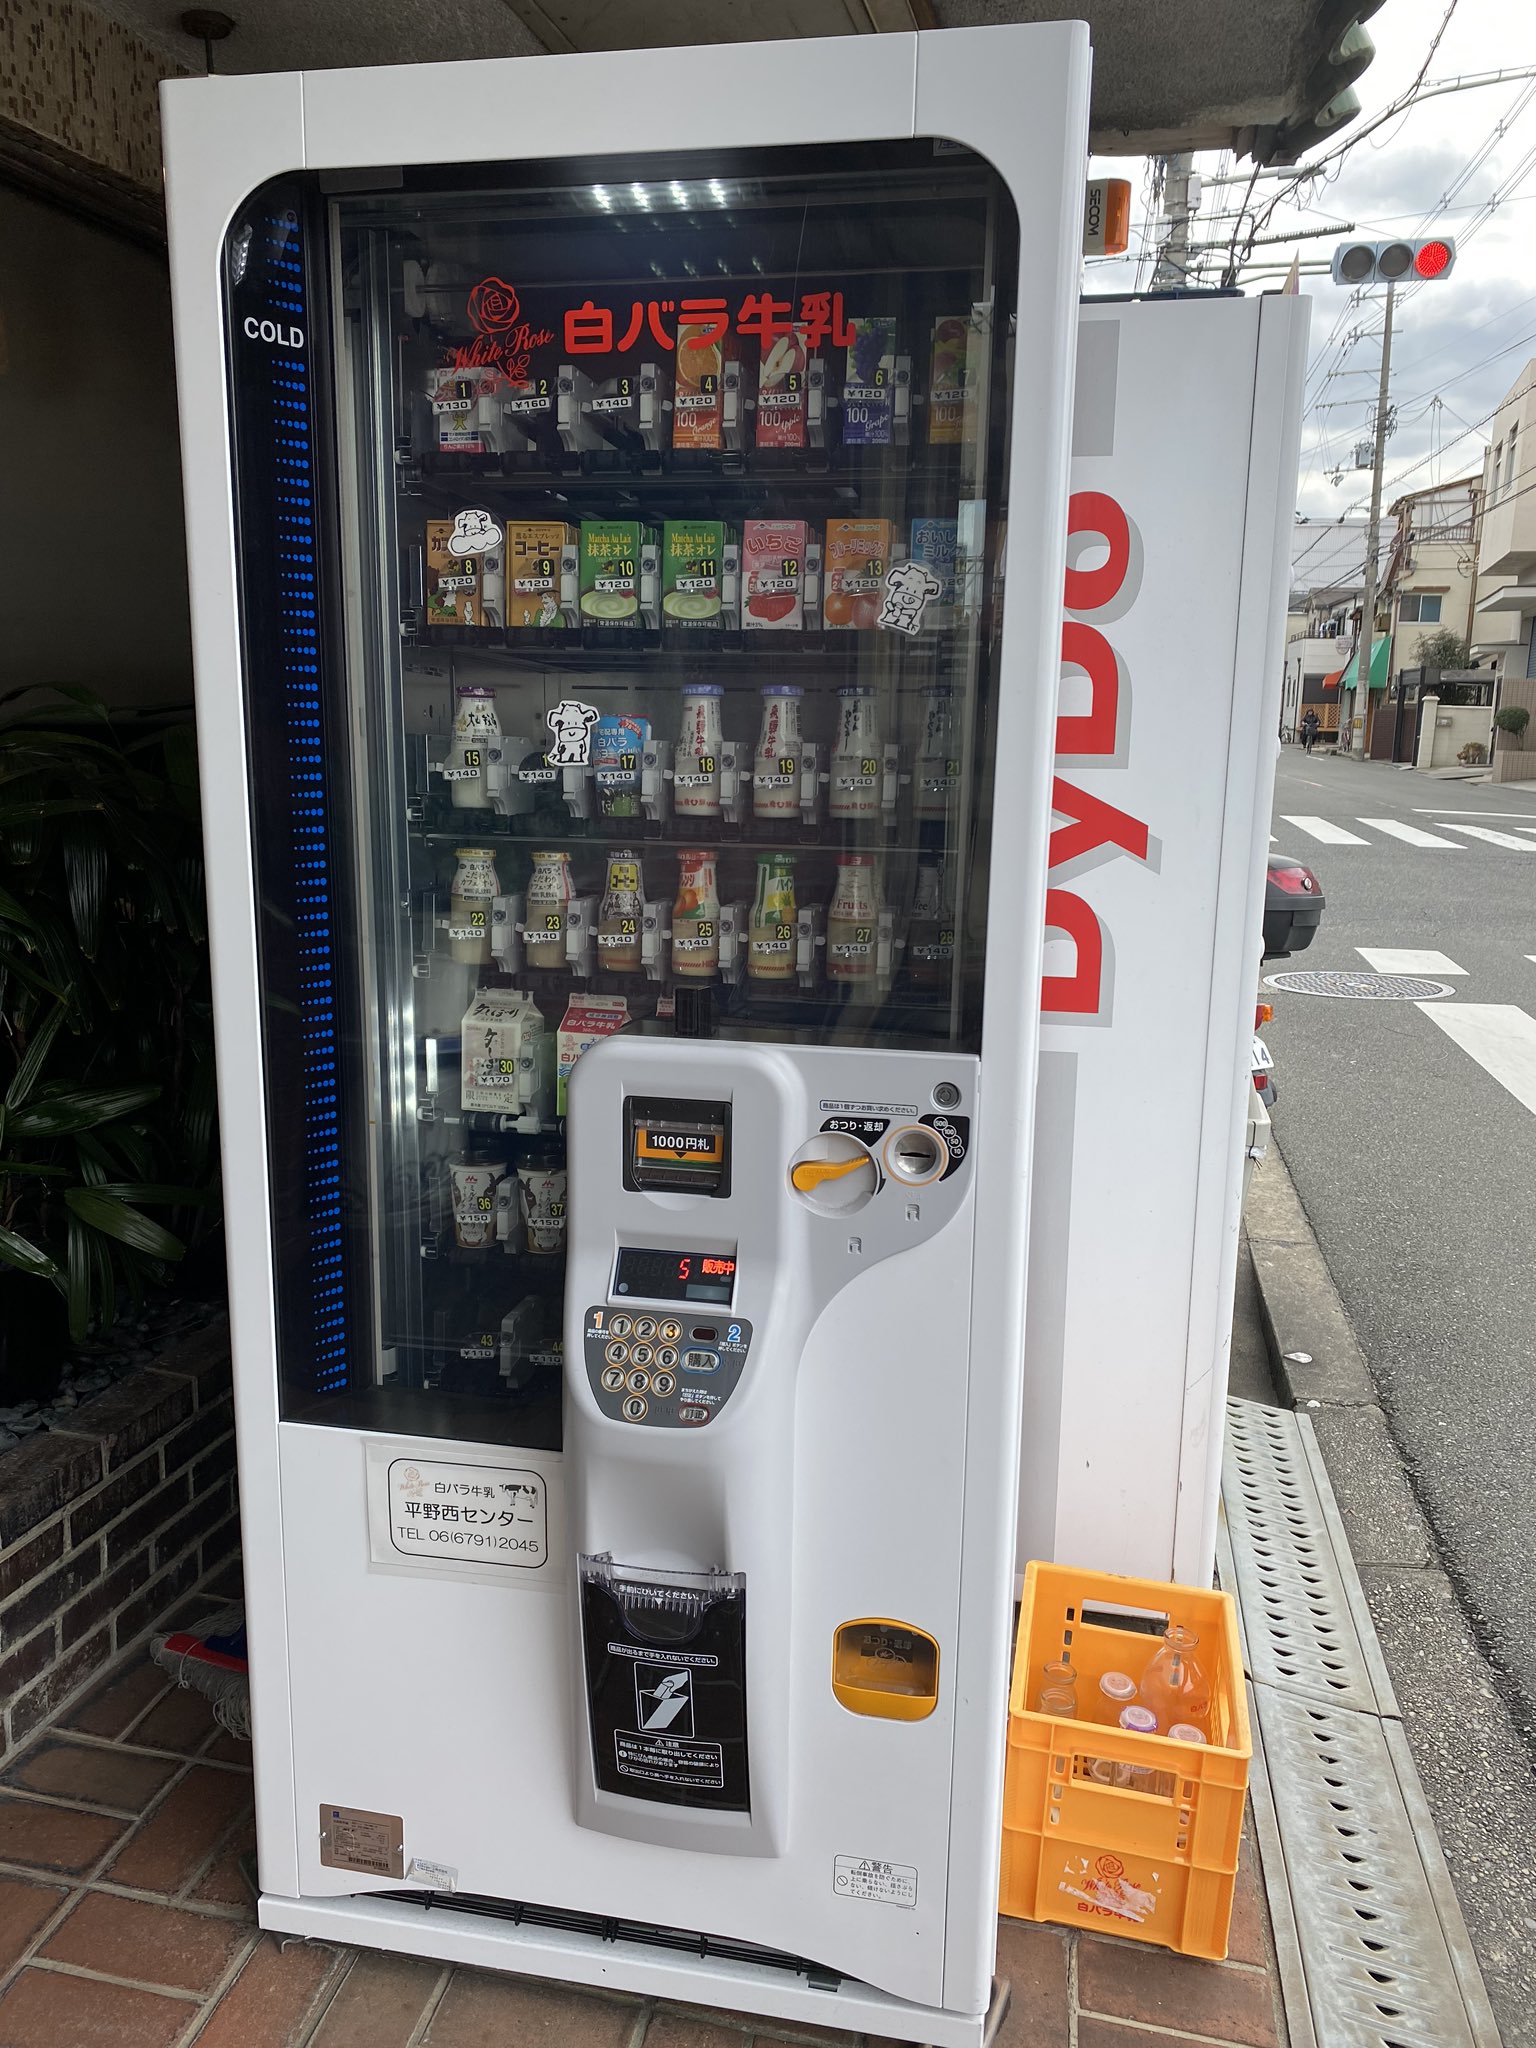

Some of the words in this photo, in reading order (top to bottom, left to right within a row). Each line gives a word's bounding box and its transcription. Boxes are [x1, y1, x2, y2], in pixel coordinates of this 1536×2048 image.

[1088, 188, 1100, 236] SECOM
[565, 291, 857, 354] 白バラ牛乳
[244, 316, 304, 348] COLD
[446, 334, 502, 375] White
[504, 322, 555, 357] Rose
[704, 376, 712, 392] 4
[788, 374, 797, 391] 5
[875, 370, 883, 386] 6
[459, 383, 468, 398] 1
[539, 380, 548, 394] 2
[621, 378, 629, 394] 3
[848, 388, 882, 398] ¥120
[678, 396, 712, 406] ¥120
[762, 394, 797, 404] ¥120
[934, 389, 969, 399] ¥120
[436, 400, 468, 410] ¥130
[514, 398, 547, 409] ¥160
[596, 398, 629, 408] ¥140
[676, 412, 697, 428] 100
[760, 411, 781, 427] 100
[846, 407, 869, 422] 100
[692, 418, 717, 436] Orange
[865, 414, 889, 432] Grape
[514, 540, 561, 556] コーヒー
[587, 544, 632, 558] 抹茶オレ
[670, 544, 716, 558] 抹茶オレ
[746, 533, 803, 555] いちご
[465, 560, 472, 574] 8
[542, 560, 550, 576] 9
[619, 560, 633, 576] 10
[700, 560, 714, 576] 11
[783, 560, 797, 576] 12
[868, 560, 882, 576] 13
[442, 577, 473, 586] ¥120
[518, 580, 550, 588] ¥120
[599, 580, 631, 588] ¥120
[680, 579, 712, 588] ¥120
[760, 579, 793, 588] ¥120
[845, 579, 879, 588] ¥120
[466, 751, 480, 766] 15
[621, 754, 635, 769] 17
[700, 757, 714, 772] 18
[780, 758, 794, 774] 19
[862, 759, 876, 774] 20
[447, 770, 478, 778] ¥140
[522, 770, 554, 779] ¥140
[602, 772, 632, 780] ¥140
[678, 775, 710, 784] ¥140
[758, 776, 790, 784] ¥140
[840, 778, 872, 786] ¥140
[923, 778, 957, 787] ¥140
[533, 874, 557, 883] こだわり
[471, 912, 485, 926] 22
[546, 916, 560, 930] 23
[452, 929, 482, 937] ¥140
[622, 920, 636, 934] 24
[698, 922, 713, 936] 25
[777, 925, 791, 939] 26
[856, 928, 871, 942] 27
[940, 930, 954, 944] 28
[678, 940, 709, 948] ¥140
[756, 942, 788, 950] ¥140
[836, 944, 868, 952] ¥140
[917, 947, 950, 955] ¥140
[566, 1019, 616, 1030] 白バラ牛乳
[500, 1060, 514, 1073] 30
[829, 1120, 884, 1132] おつり・返却
[652, 1135, 710, 1150] 1000円札
[478, 1198, 492, 1210] 36
[551, 1204, 564, 1216] 37
[702, 1258, 735, 1276] 販売中
[594, 1311, 604, 1329] 1
[618, 1320, 625, 1334] 1
[640, 1321, 651, 1336] 2
[666, 1324, 676, 1338] 3
[727, 1324, 742, 1342] 2
[480, 1334, 493, 1346] 43
[463, 1350, 492, 1358] ¥110
[532, 1355, 561, 1363] ¥110
[612, 1345, 622, 1360] 4
[638, 1348, 648, 1362] 5
[662, 1350, 672, 1364] 6
[688, 1353, 715, 1368] 購入
[610, 1371, 620, 1386] 7
[634, 1374, 644, 1388] 8
[659, 1376, 669, 1392] 9
[630, 1400, 641, 1414] 0
[434, 1482, 496, 1498] 白バラ牛乳
[404, 1501, 534, 1526] 平野西センター
[397, 1526, 426, 1541] TEL
[428, 1529, 538, 1552] 06(6791)2045
[619, 1584, 700, 1600] 手前にひいてください。
[610, 1644, 716, 1664] 商品が出るまで手を入れないでください。
[872, 1862, 893, 1874] 警告
